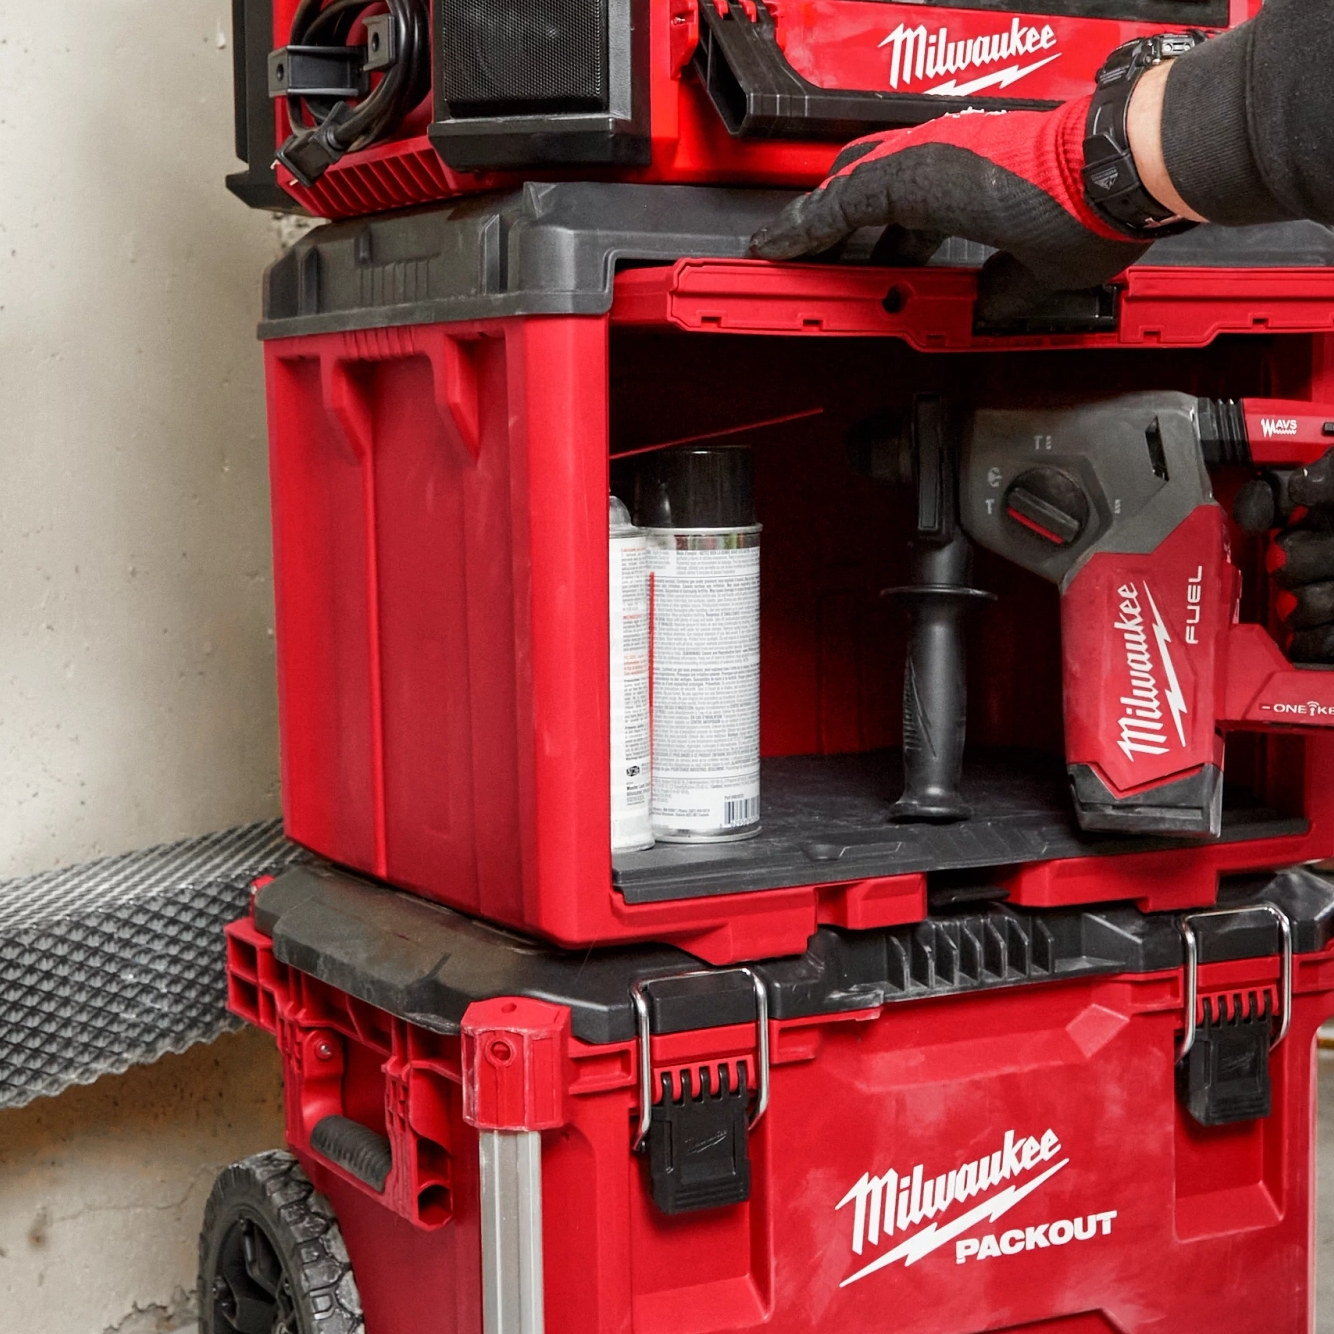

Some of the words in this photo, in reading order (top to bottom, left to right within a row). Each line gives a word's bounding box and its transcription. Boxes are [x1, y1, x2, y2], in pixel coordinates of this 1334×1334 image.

[877, 17, 1057, 90] Milwaukee
[1185, 565, 1203, 645] FUEL
[1114, 581, 1170, 763] Milwaukee
[835, 1128, 1062, 1256] Milwaukee
[956, 1210, 1118, 1265] PACKOUT
